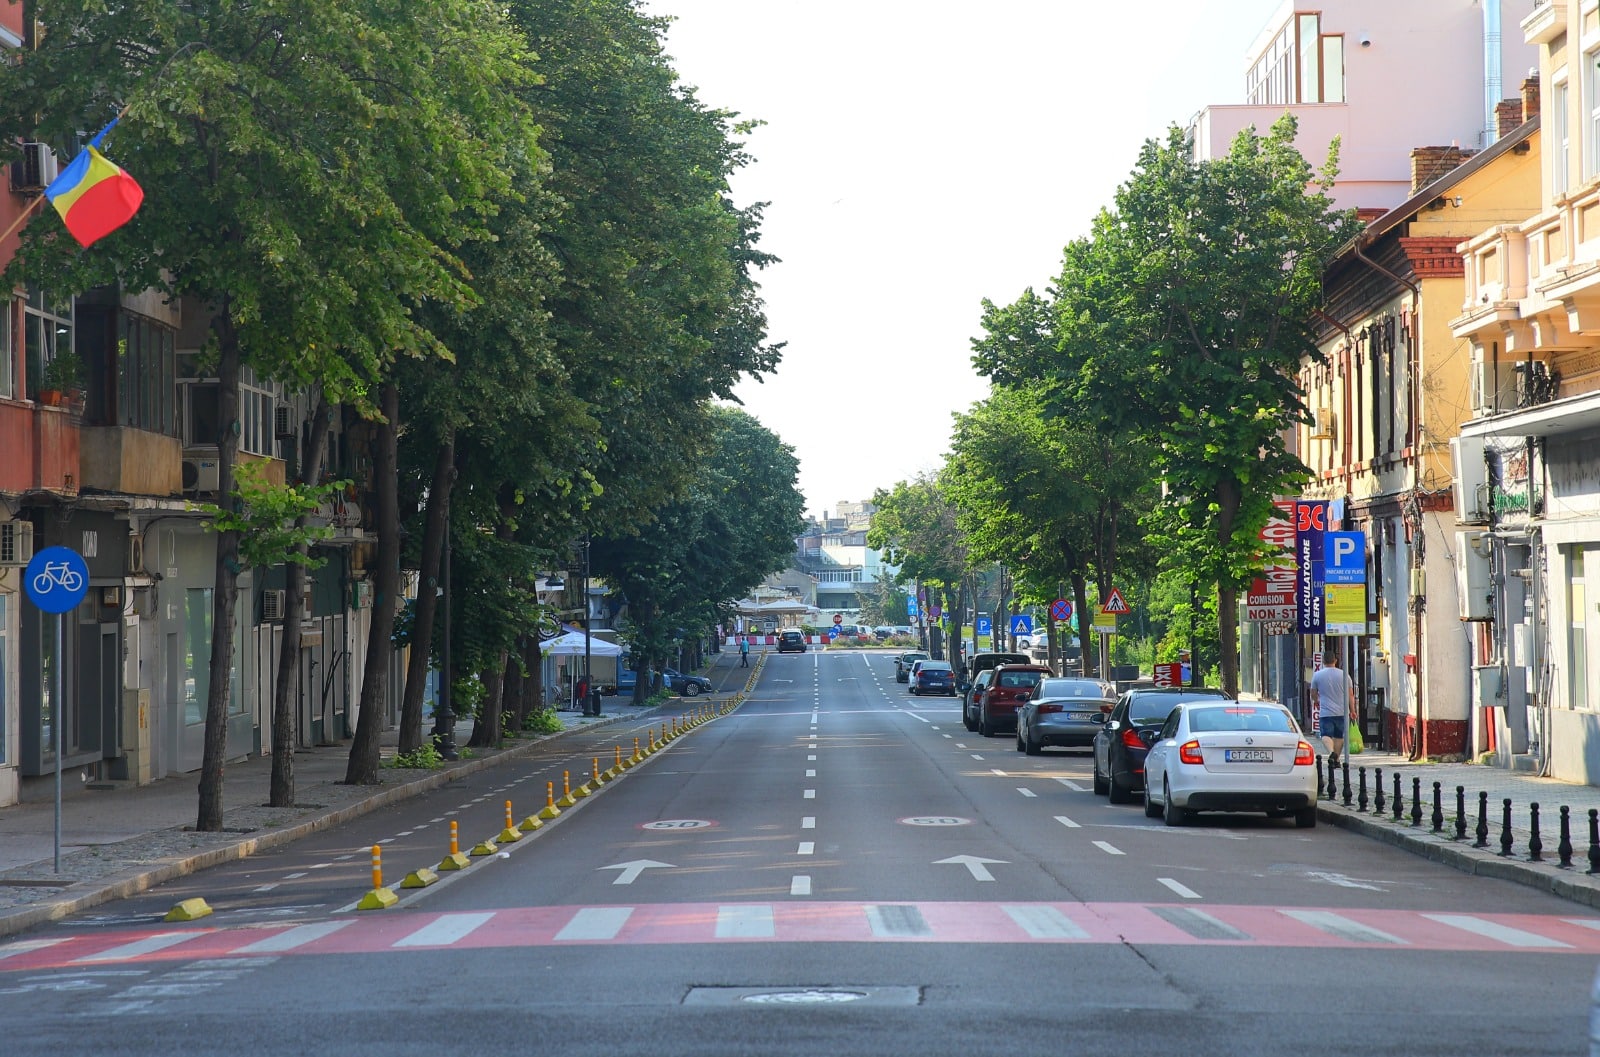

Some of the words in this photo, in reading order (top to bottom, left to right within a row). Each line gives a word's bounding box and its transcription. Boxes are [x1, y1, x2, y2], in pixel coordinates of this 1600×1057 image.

[1298, 505, 1323, 531] 3C
[1334, 537, 1355, 566] P
[1249, 595, 1285, 605] COMISION
[1231, 751, 1242, 760] CT
[1244, 751, 1253, 760] 21
[1253, 751, 1270, 760] PCL
[653, 821, 699, 829] 50
